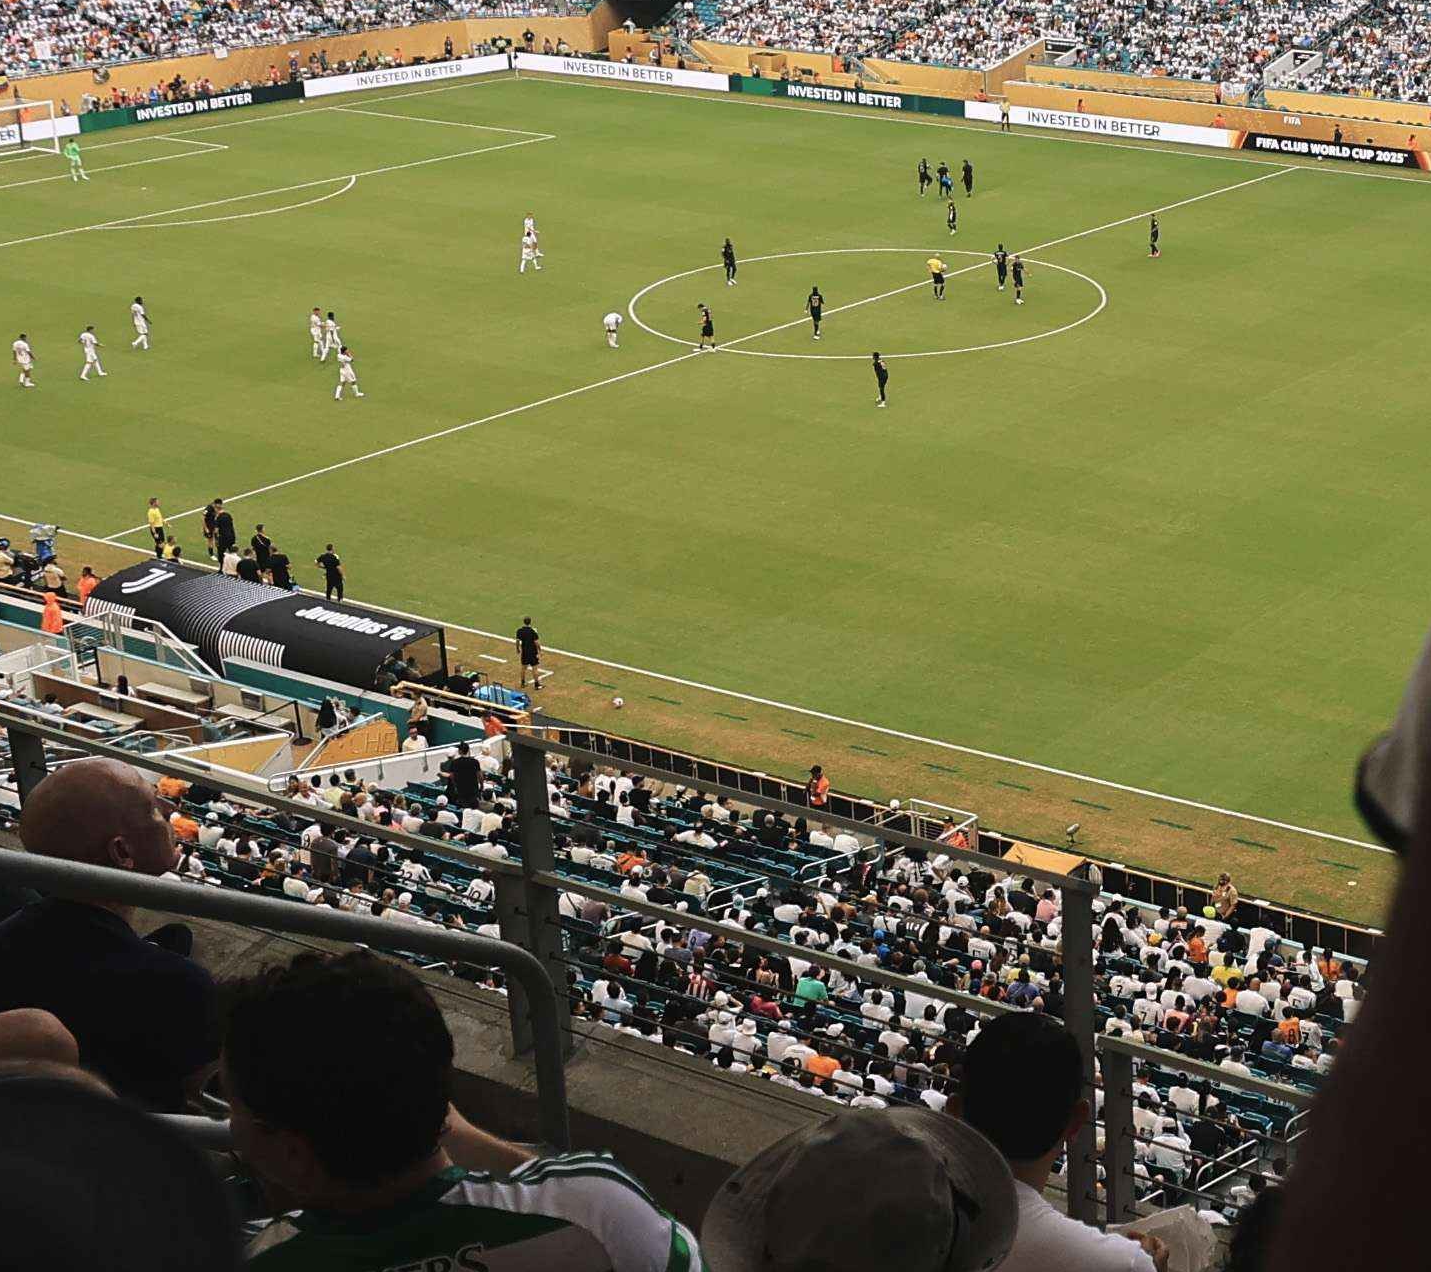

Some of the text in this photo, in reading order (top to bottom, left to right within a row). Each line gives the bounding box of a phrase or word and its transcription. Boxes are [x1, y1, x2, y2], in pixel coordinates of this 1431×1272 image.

[356, 63, 462, 86] INVESTED IN BETTER
[563, 61, 673, 82] INVESTED IN BETTER
[136, 93, 252, 121] INVESTED IN BETTER
[787, 85, 901, 109] INVESTED IN BETTER
[1027, 111, 1160, 138] INVESTED IN BETTER
[1283, 116, 1301, 126] FIFA
[1255, 137, 1280, 150] FIFA
[1280, 139, 1309, 153] CLUB
[1310, 142, 1350, 159] WORLD
[1351, 146, 1375, 161] CUP
[295, 606, 416, 641] Juventus FC
